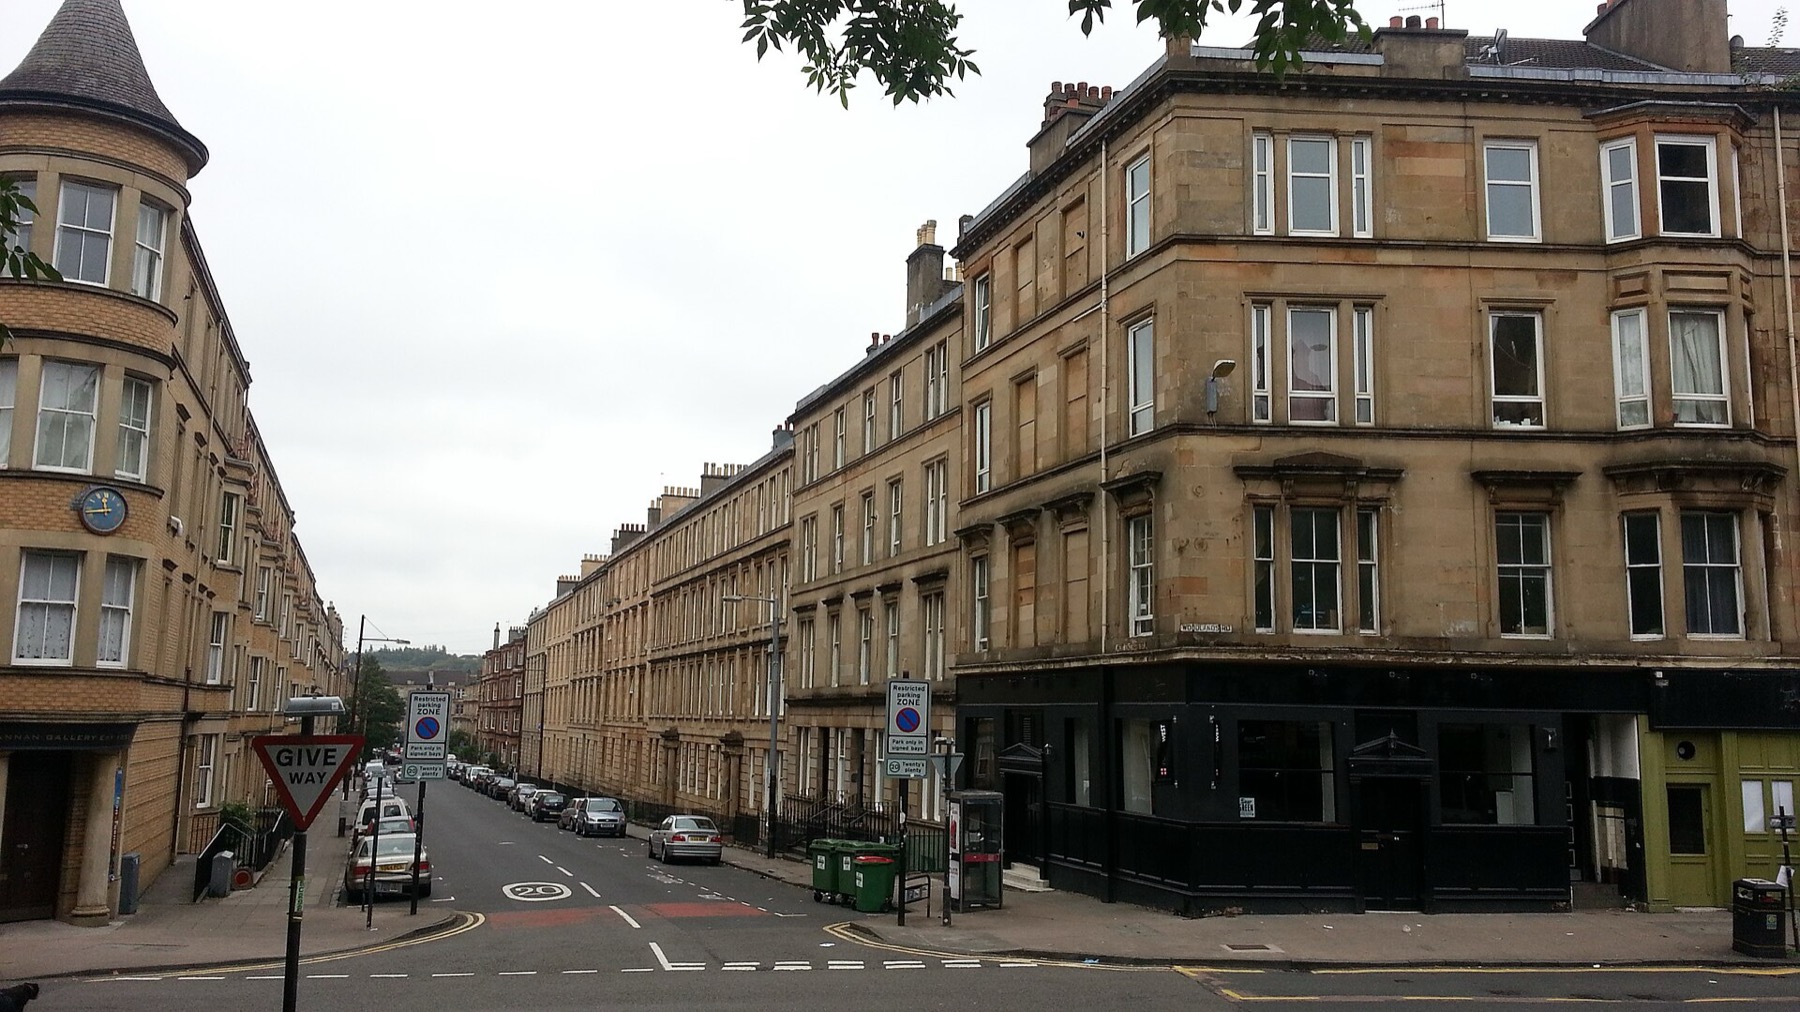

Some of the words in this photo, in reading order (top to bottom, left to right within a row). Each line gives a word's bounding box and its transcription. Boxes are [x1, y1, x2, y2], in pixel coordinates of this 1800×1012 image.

[276, 748, 337, 767] GIVE
[289, 771, 327, 785] WAY
[515, 886, 561, 896] 20
